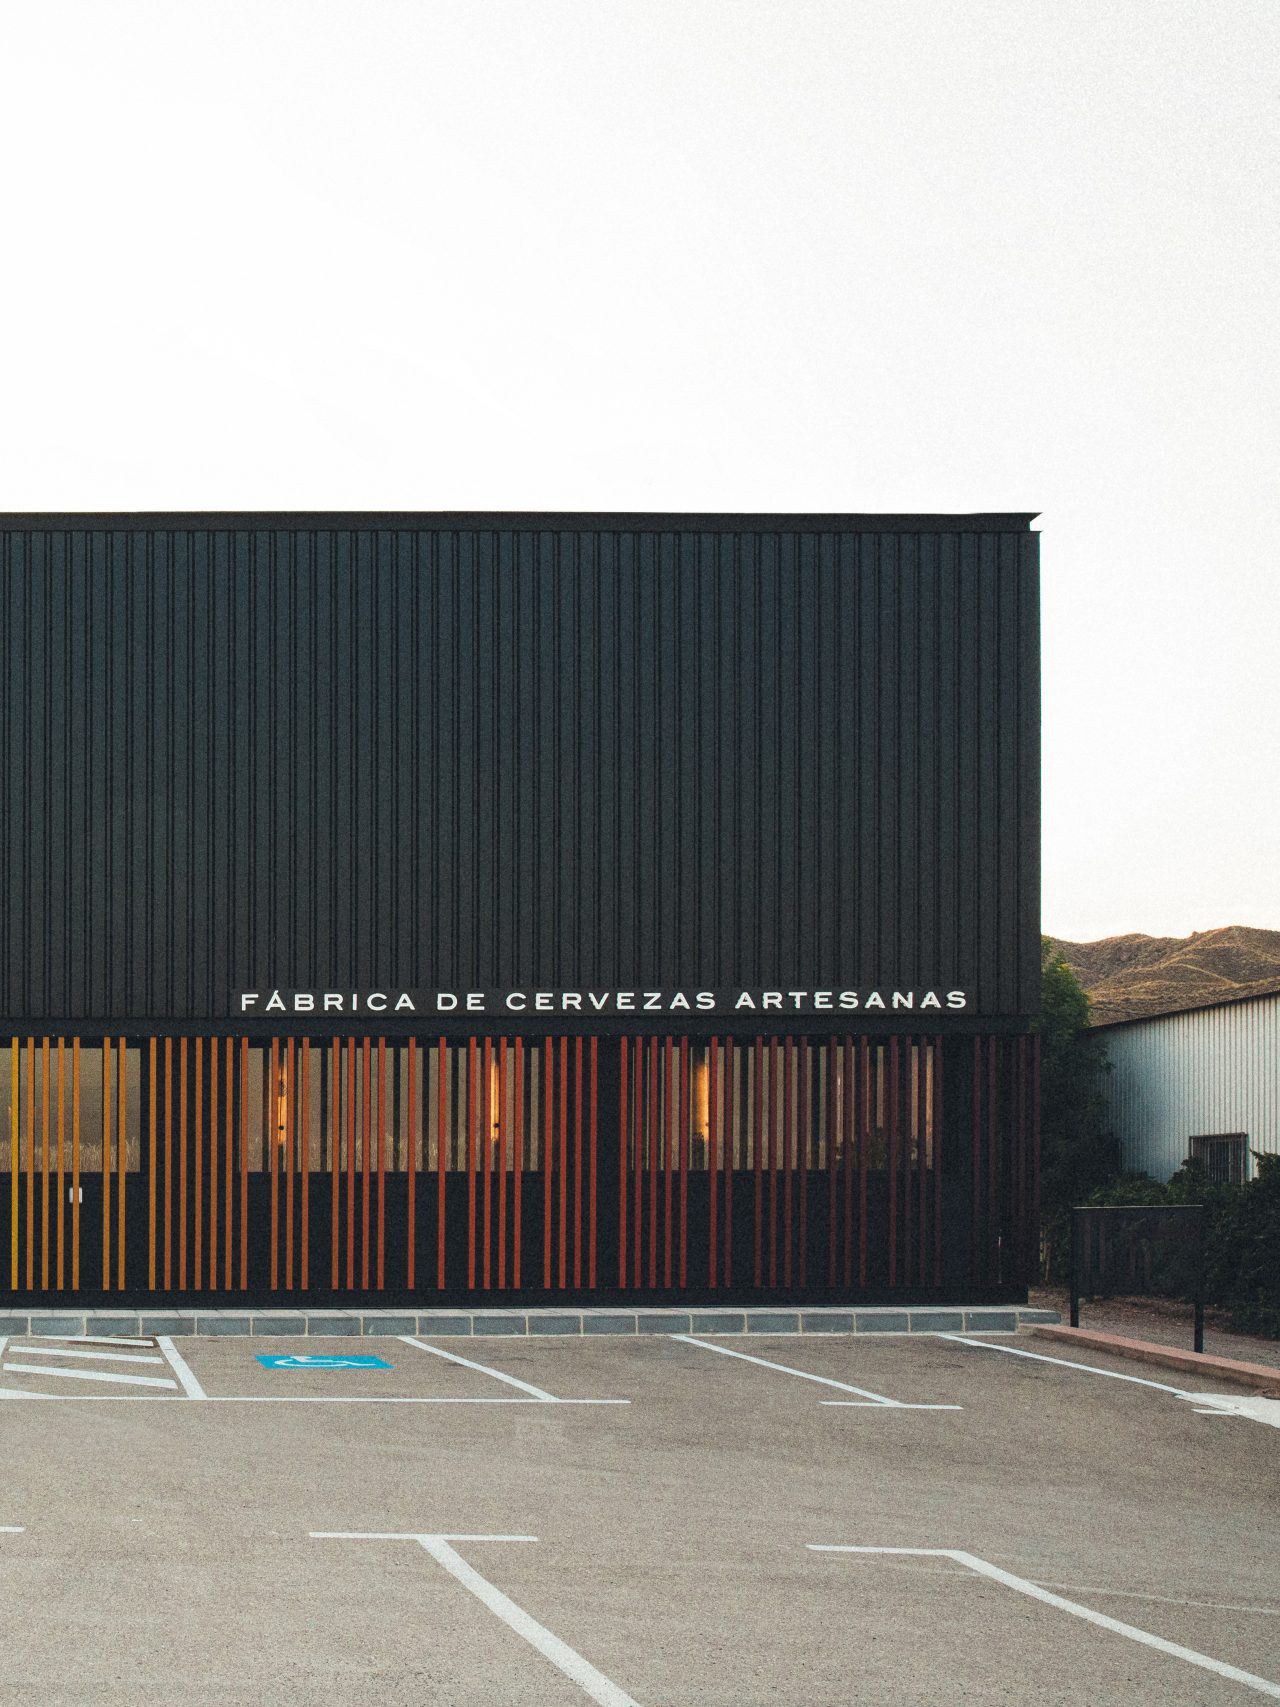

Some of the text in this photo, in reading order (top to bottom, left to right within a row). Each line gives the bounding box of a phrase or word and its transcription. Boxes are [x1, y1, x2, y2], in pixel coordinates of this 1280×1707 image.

[240, 989, 967, 1011] FÁBRICA DE CERVEZAS ARTESANAS
